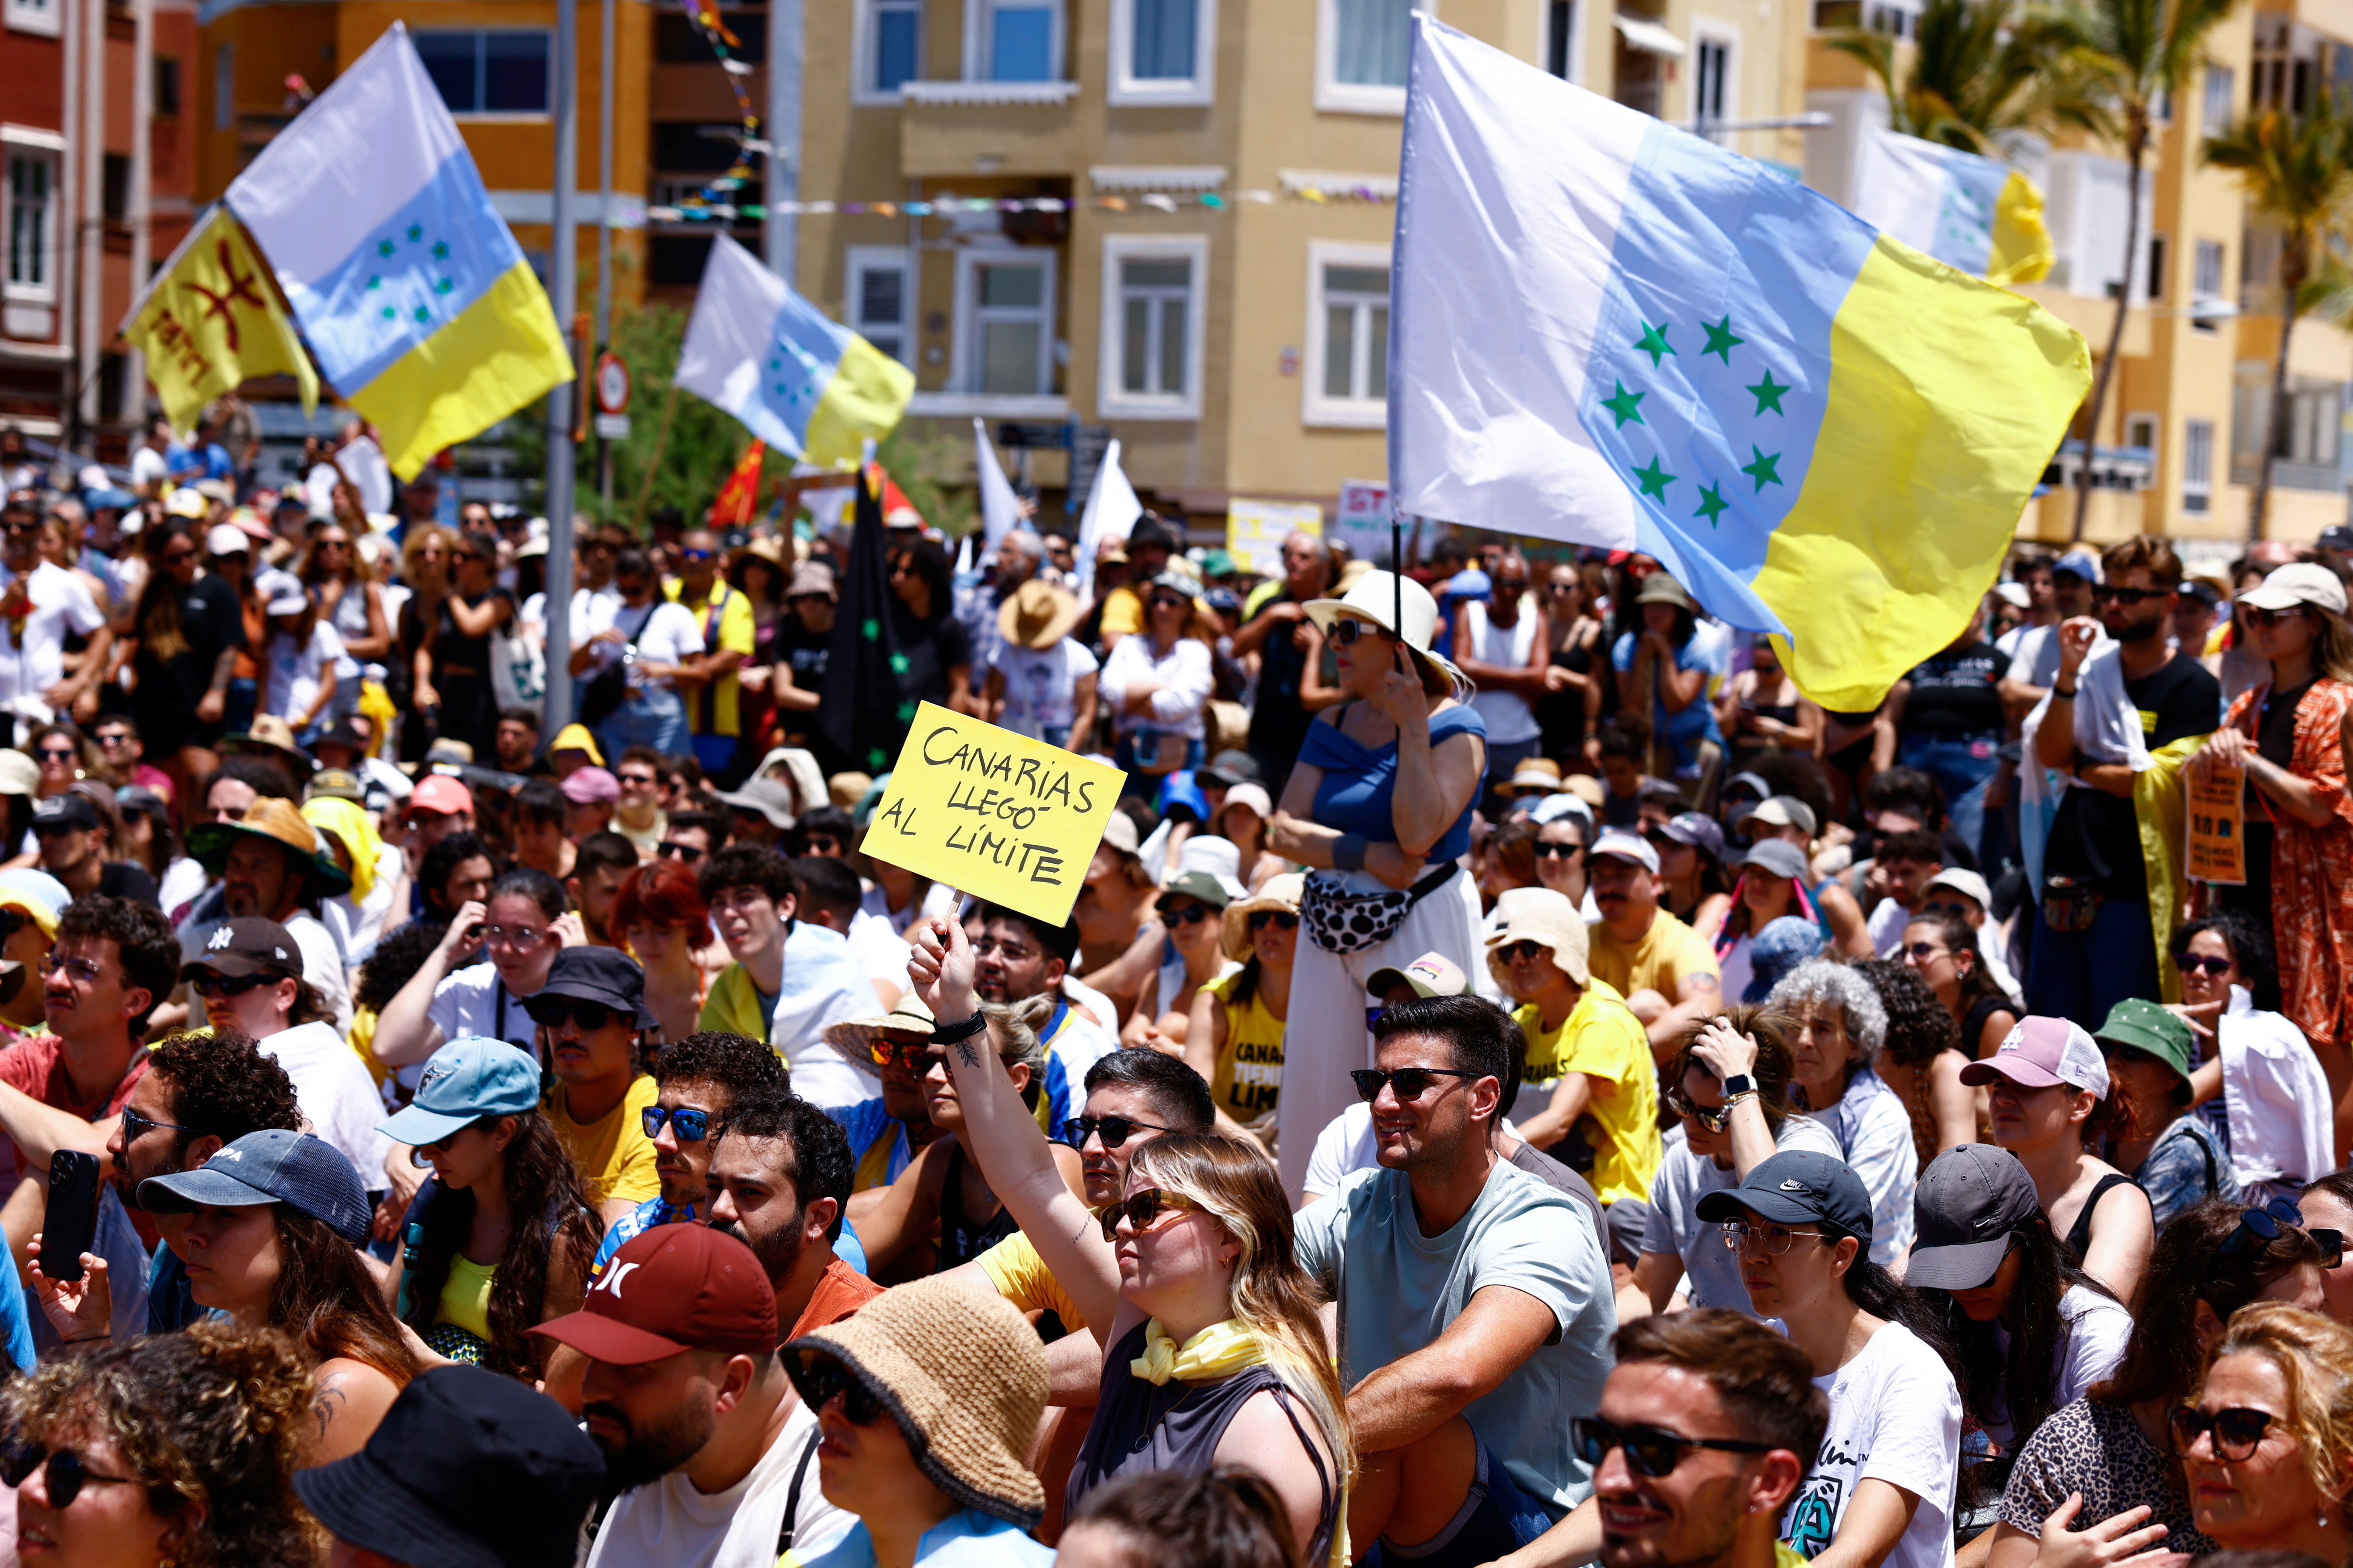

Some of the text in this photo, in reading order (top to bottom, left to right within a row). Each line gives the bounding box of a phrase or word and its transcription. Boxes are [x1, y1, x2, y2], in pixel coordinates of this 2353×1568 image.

[923, 727, 1094, 813] CANARIAS
[947, 781, 1051, 830] LLEGÓ
[881, 798, 1064, 886] AL LÍMITE
[1784, 1178, 1805, 1189] NIKE
